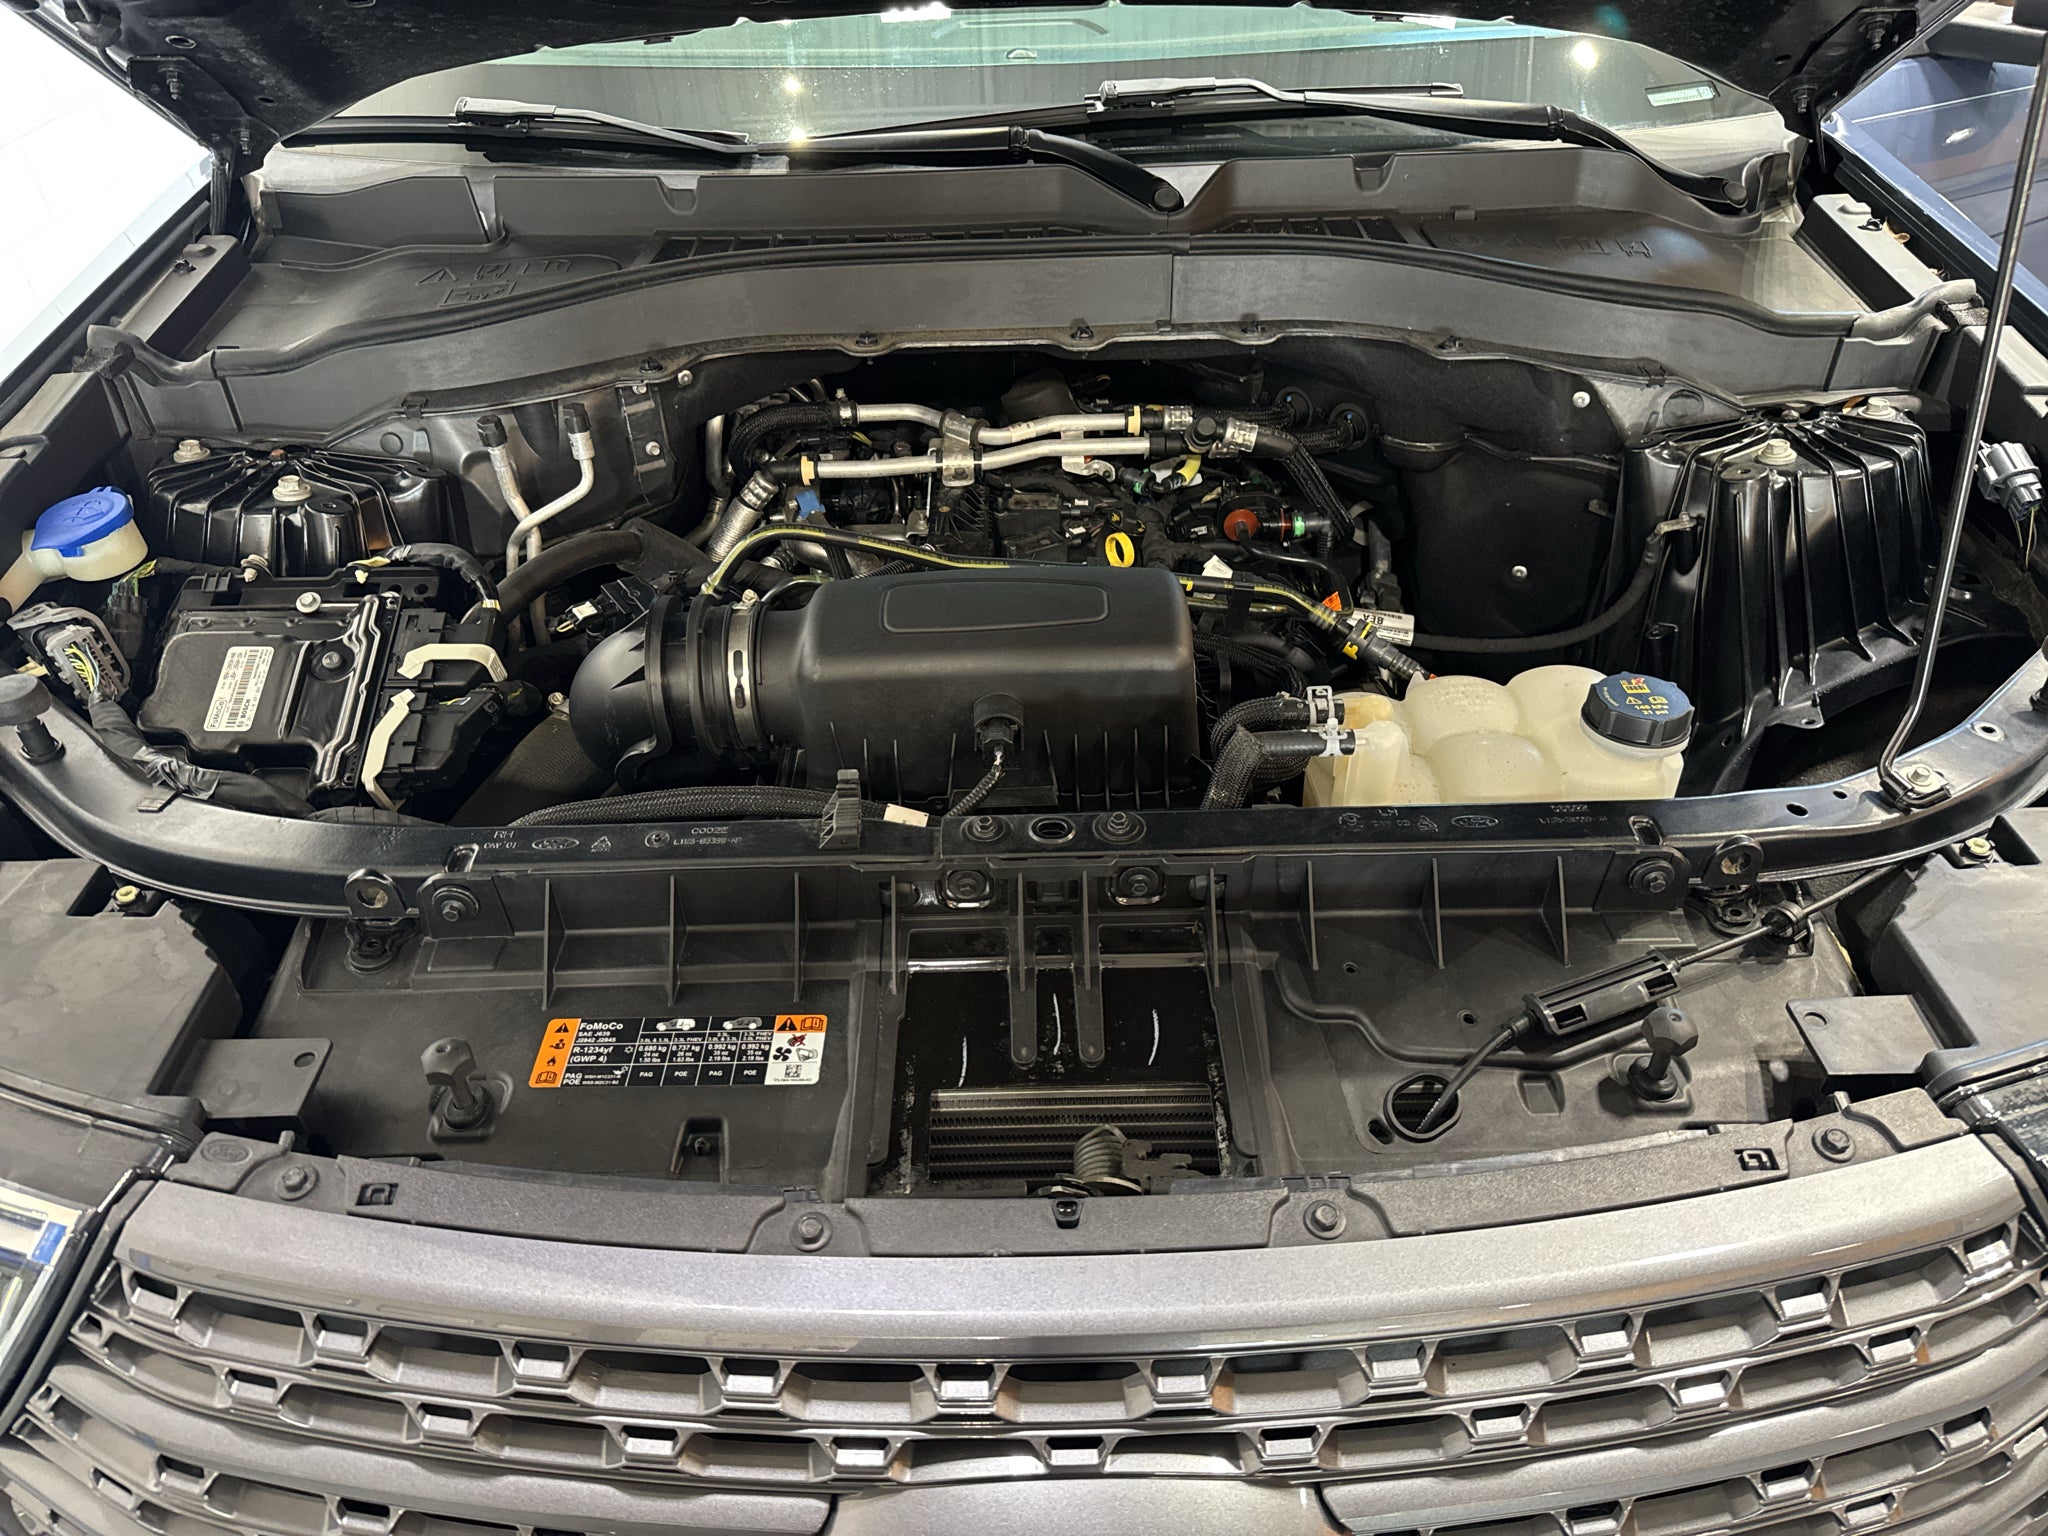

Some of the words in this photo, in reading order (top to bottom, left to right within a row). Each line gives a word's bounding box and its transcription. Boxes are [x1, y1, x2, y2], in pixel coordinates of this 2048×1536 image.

[240, 699, 252, 719] BOSCH
[210, 701, 225, 728] FoMoCo
[493, 830, 515, 839] RH
[580, 1022, 624, 1030] FoMoCo
[573, 1046, 614, 1054] R-1234yf
[570, 1055, 597, 1063] (GWP
[598, 1055, 608, 1063] 4)
